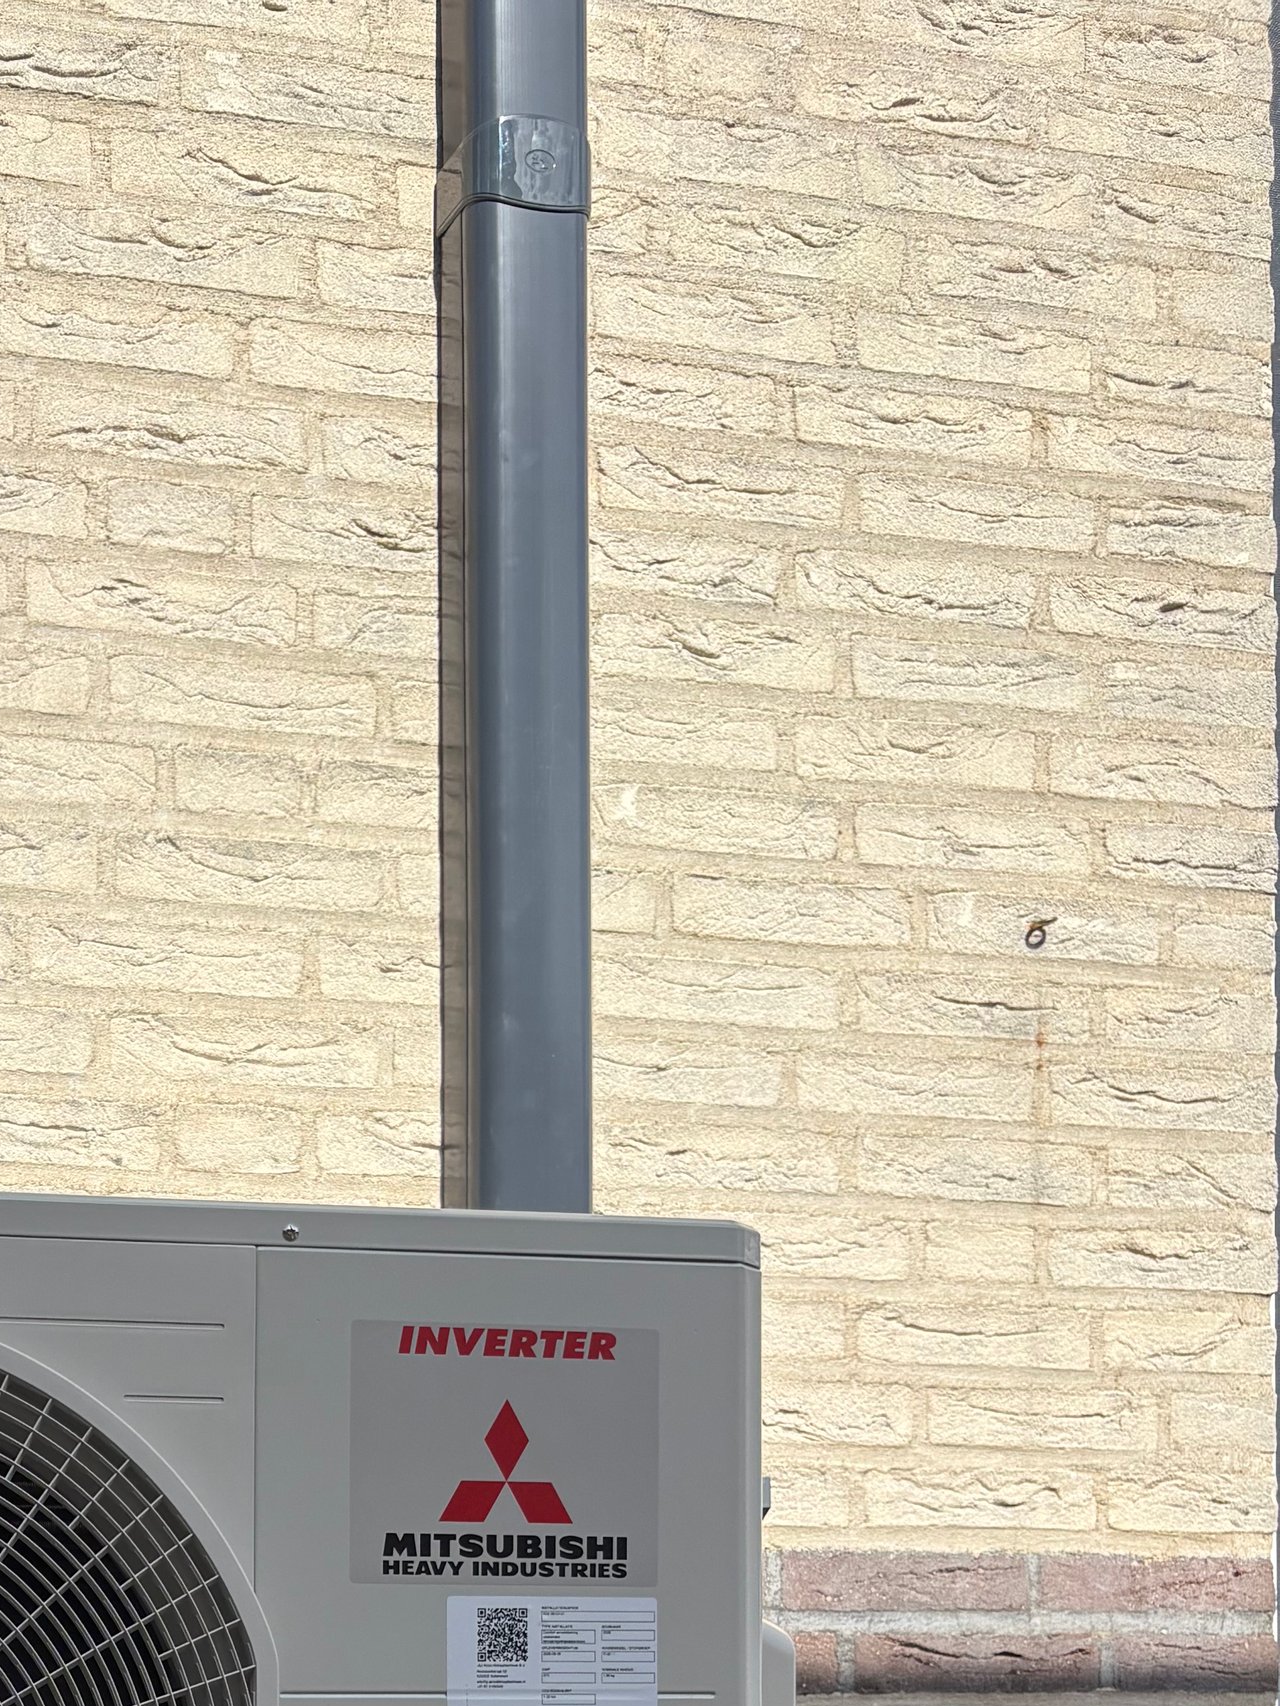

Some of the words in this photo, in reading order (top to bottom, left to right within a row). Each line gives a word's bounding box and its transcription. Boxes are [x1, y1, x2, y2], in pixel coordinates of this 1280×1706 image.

[398, 1325, 617, 1361] INVERTER
[382, 1532, 628, 1561] MITSUBISHI
[382, 1560, 464, 1576] HEAVY
[472, 1561, 628, 1579] INDUSTRIES
